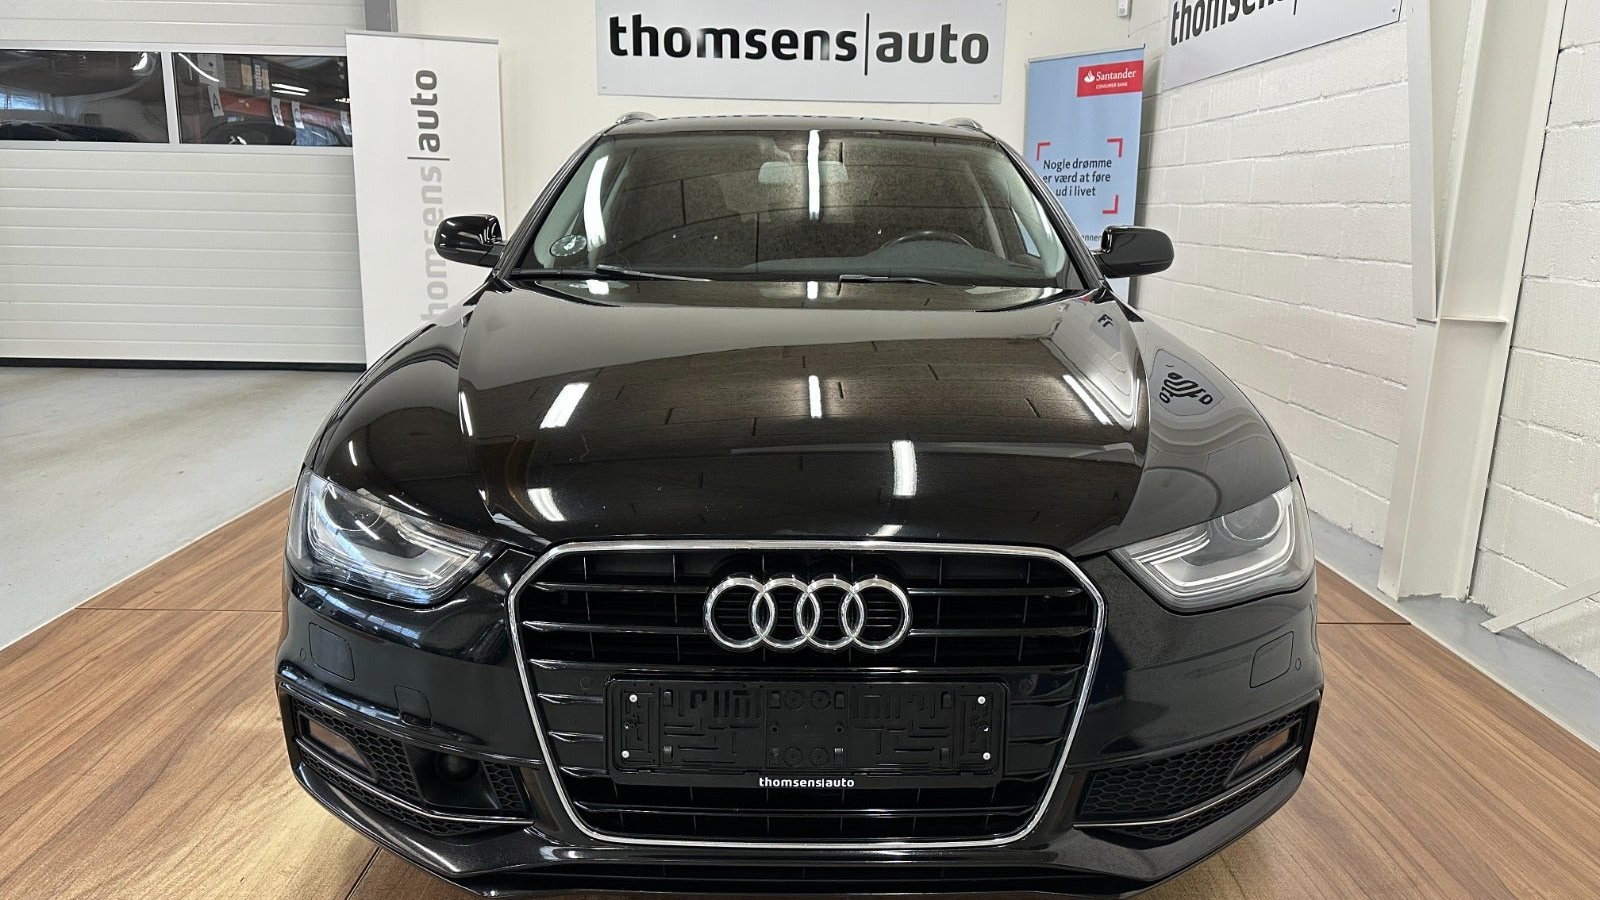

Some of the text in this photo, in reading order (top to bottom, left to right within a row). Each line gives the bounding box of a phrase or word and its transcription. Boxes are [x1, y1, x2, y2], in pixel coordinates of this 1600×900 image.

[1096, 68, 1137, 81] Santander
[1043, 158, 1112, 172] Nogle drømme
[1043, 171, 1111, 183] er værd at føre
[1056, 186, 1096, 196] ud i livet
